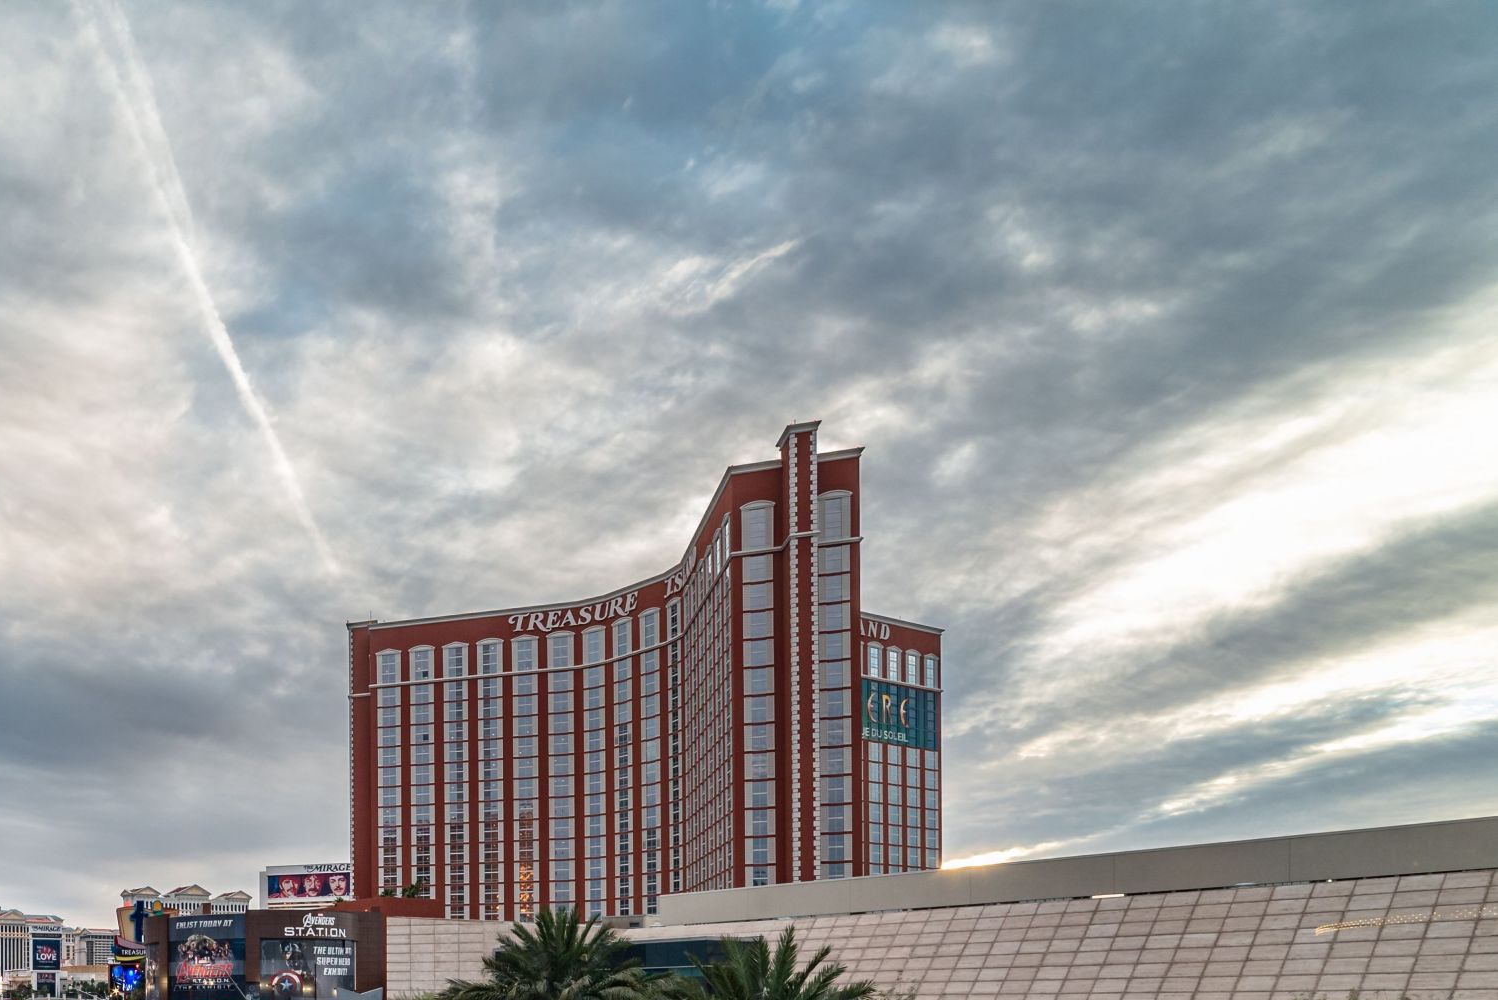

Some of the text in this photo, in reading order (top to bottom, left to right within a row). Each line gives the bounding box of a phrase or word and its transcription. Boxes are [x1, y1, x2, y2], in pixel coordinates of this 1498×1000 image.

[508, 591, 639, 632] TREASURE
[871, 728, 882, 738] DU
[883, 730, 908, 743] SOLEIL
[310, 863, 351, 873] MIRAGE
[176, 919, 233, 929] ENLIST TODAY AT
[313, 946, 327, 954] THE
[36, 953, 57, 961] LOVE
[316, 957, 337, 966] SUPER
